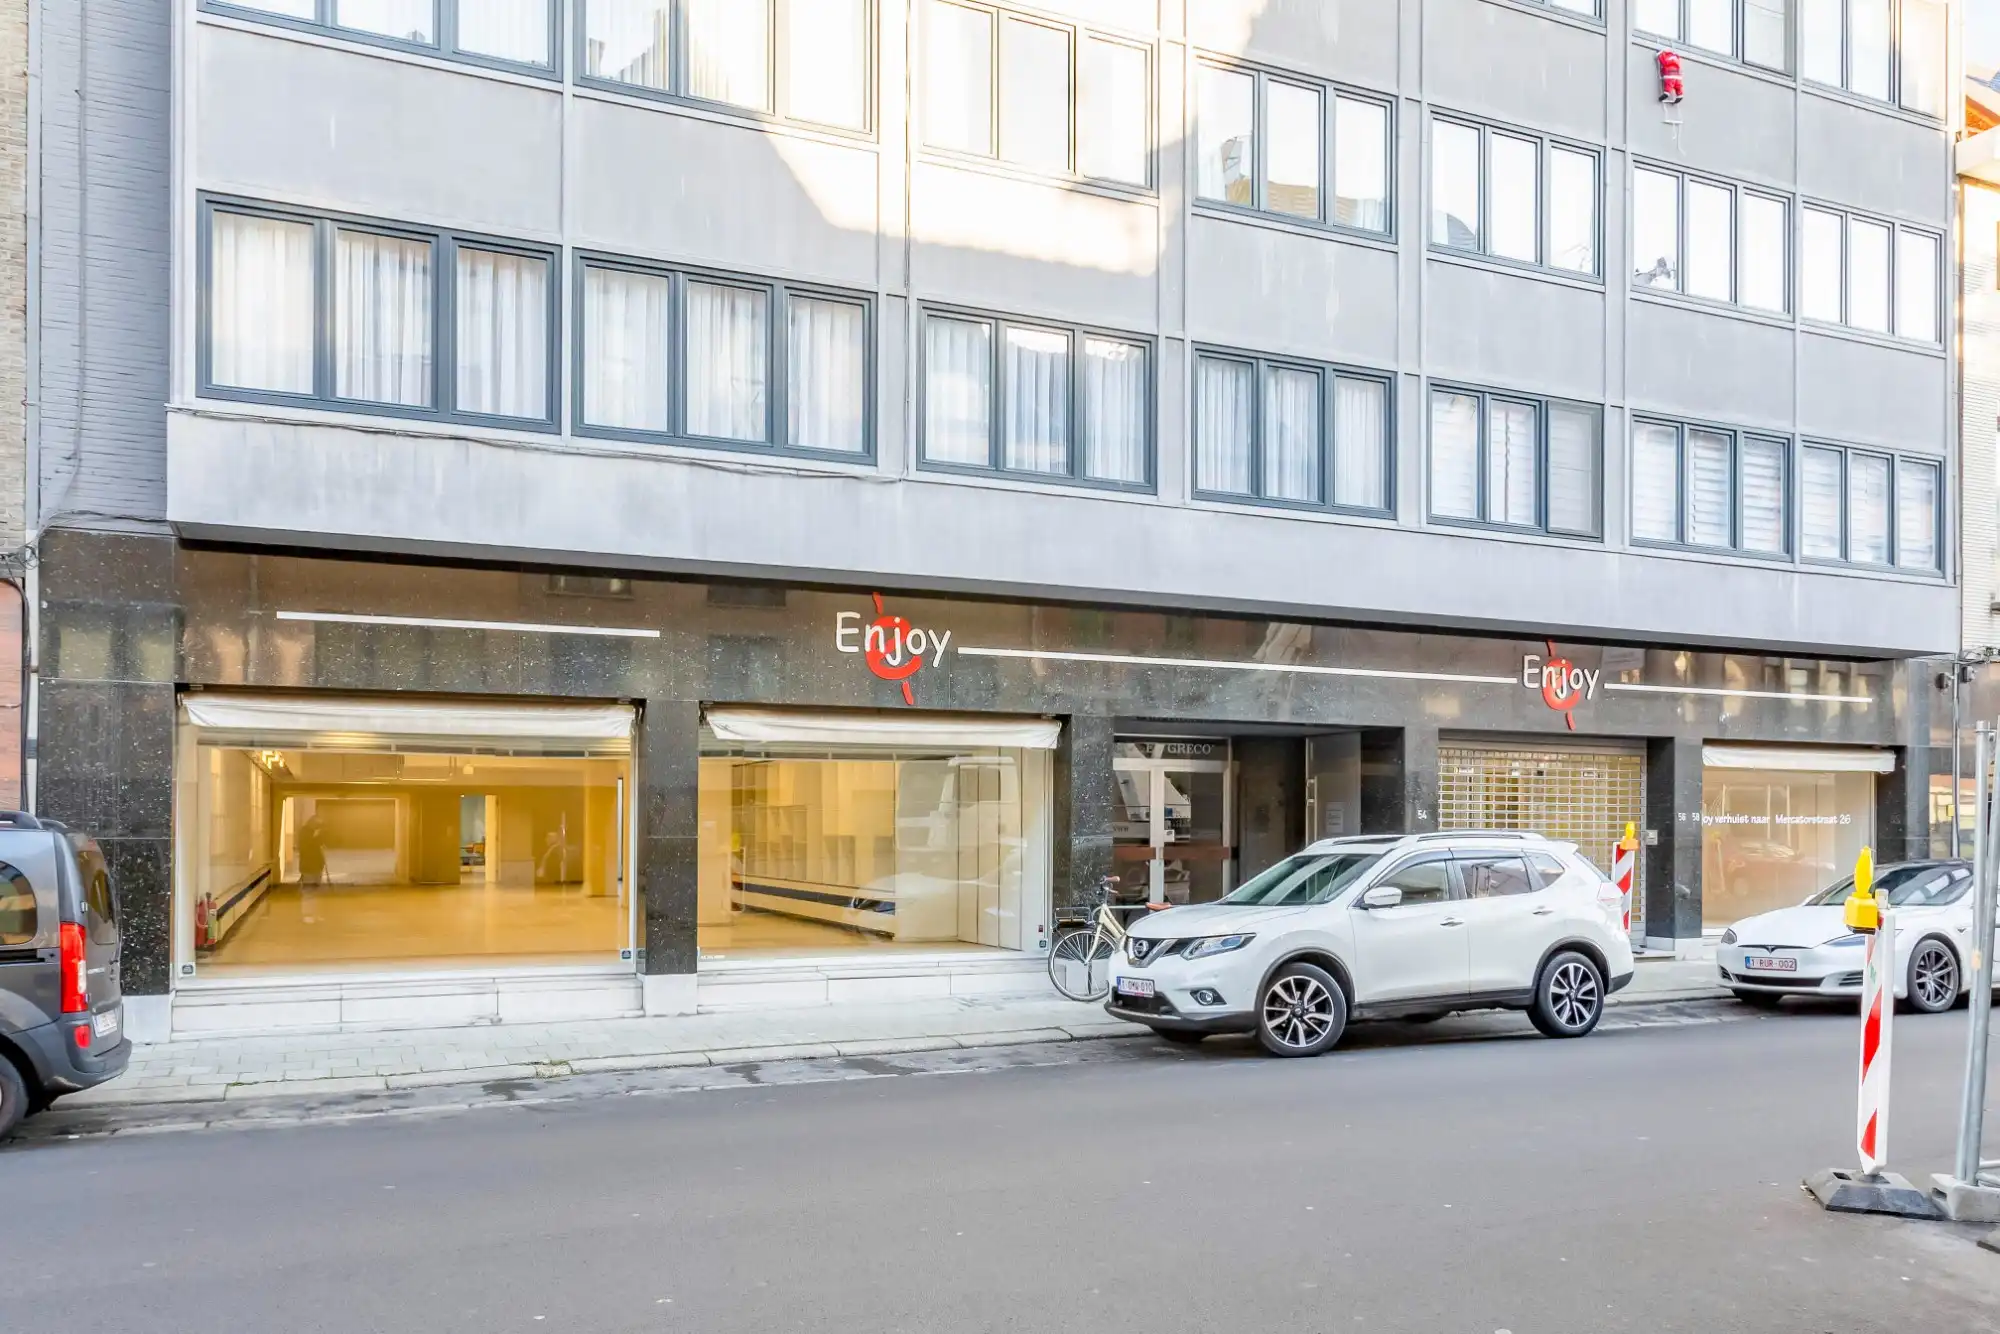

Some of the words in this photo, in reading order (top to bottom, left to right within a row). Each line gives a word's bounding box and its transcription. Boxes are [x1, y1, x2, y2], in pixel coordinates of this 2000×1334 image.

[835, 611, 952, 668] Enjoy
[1523, 654, 1600, 700] Enjoy
[1167, 743, 1211, 755] GRECO
[1417, 809, 1427, 820] 54
[1678, 812, 1687, 822] 56
[1691, 812, 1700, 822] 58
[1715, 813, 1750, 824] verhuist
[1751, 815, 1770, 824] naar
[1775, 814, 1838, 825] Mercatorstraat
[1839, 814, 1851, 825] 26
